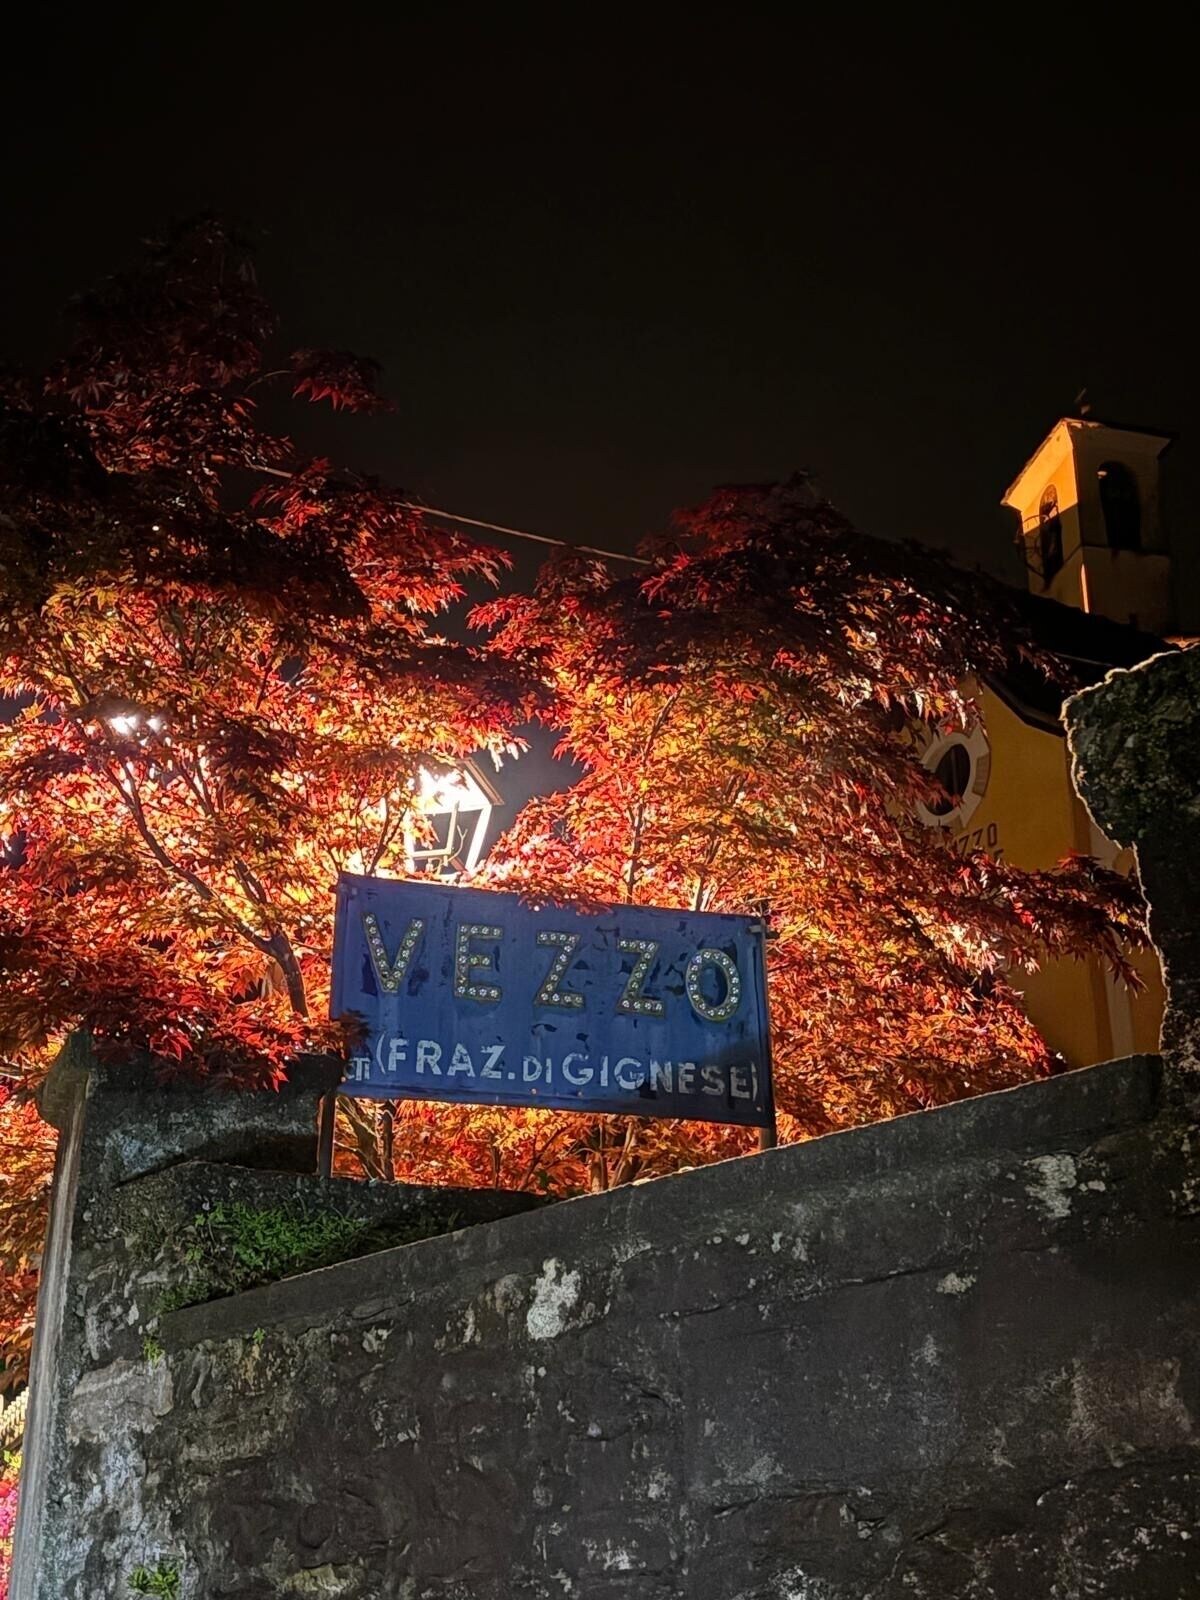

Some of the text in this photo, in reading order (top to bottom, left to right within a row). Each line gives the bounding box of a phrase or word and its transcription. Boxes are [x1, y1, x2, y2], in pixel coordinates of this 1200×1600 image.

[361, 912, 741, 1022] VEZZO
[376, 1031, 758, 1101] (FRAZ. DI GIGNESE)
